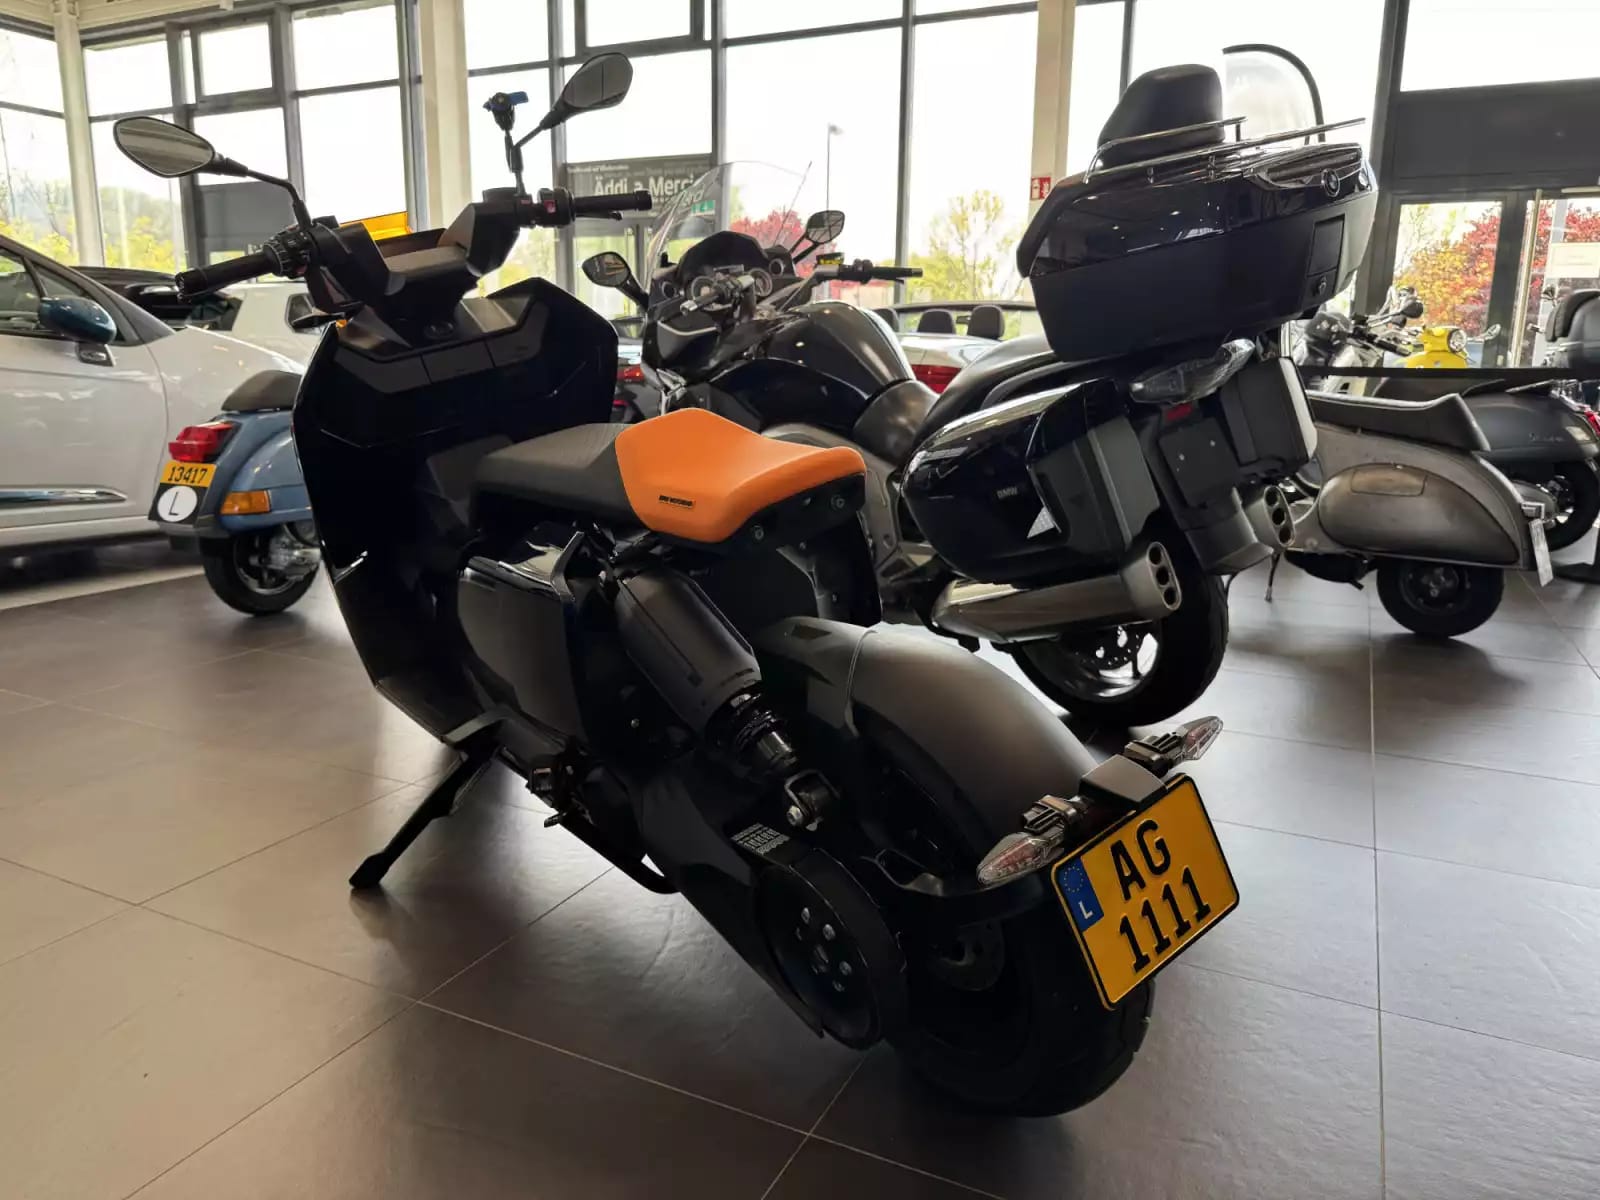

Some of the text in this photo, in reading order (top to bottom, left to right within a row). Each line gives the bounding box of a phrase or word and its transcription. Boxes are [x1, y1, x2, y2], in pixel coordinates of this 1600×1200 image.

[594, 175, 628, 197] Äddi
[167, 466, 208, 484] 13417
[168, 491, 179, 516] L
[1110, 819, 1171, 901] AG
[1078, 900, 1094, 920] L
[1119, 866, 1211, 973] 1111
